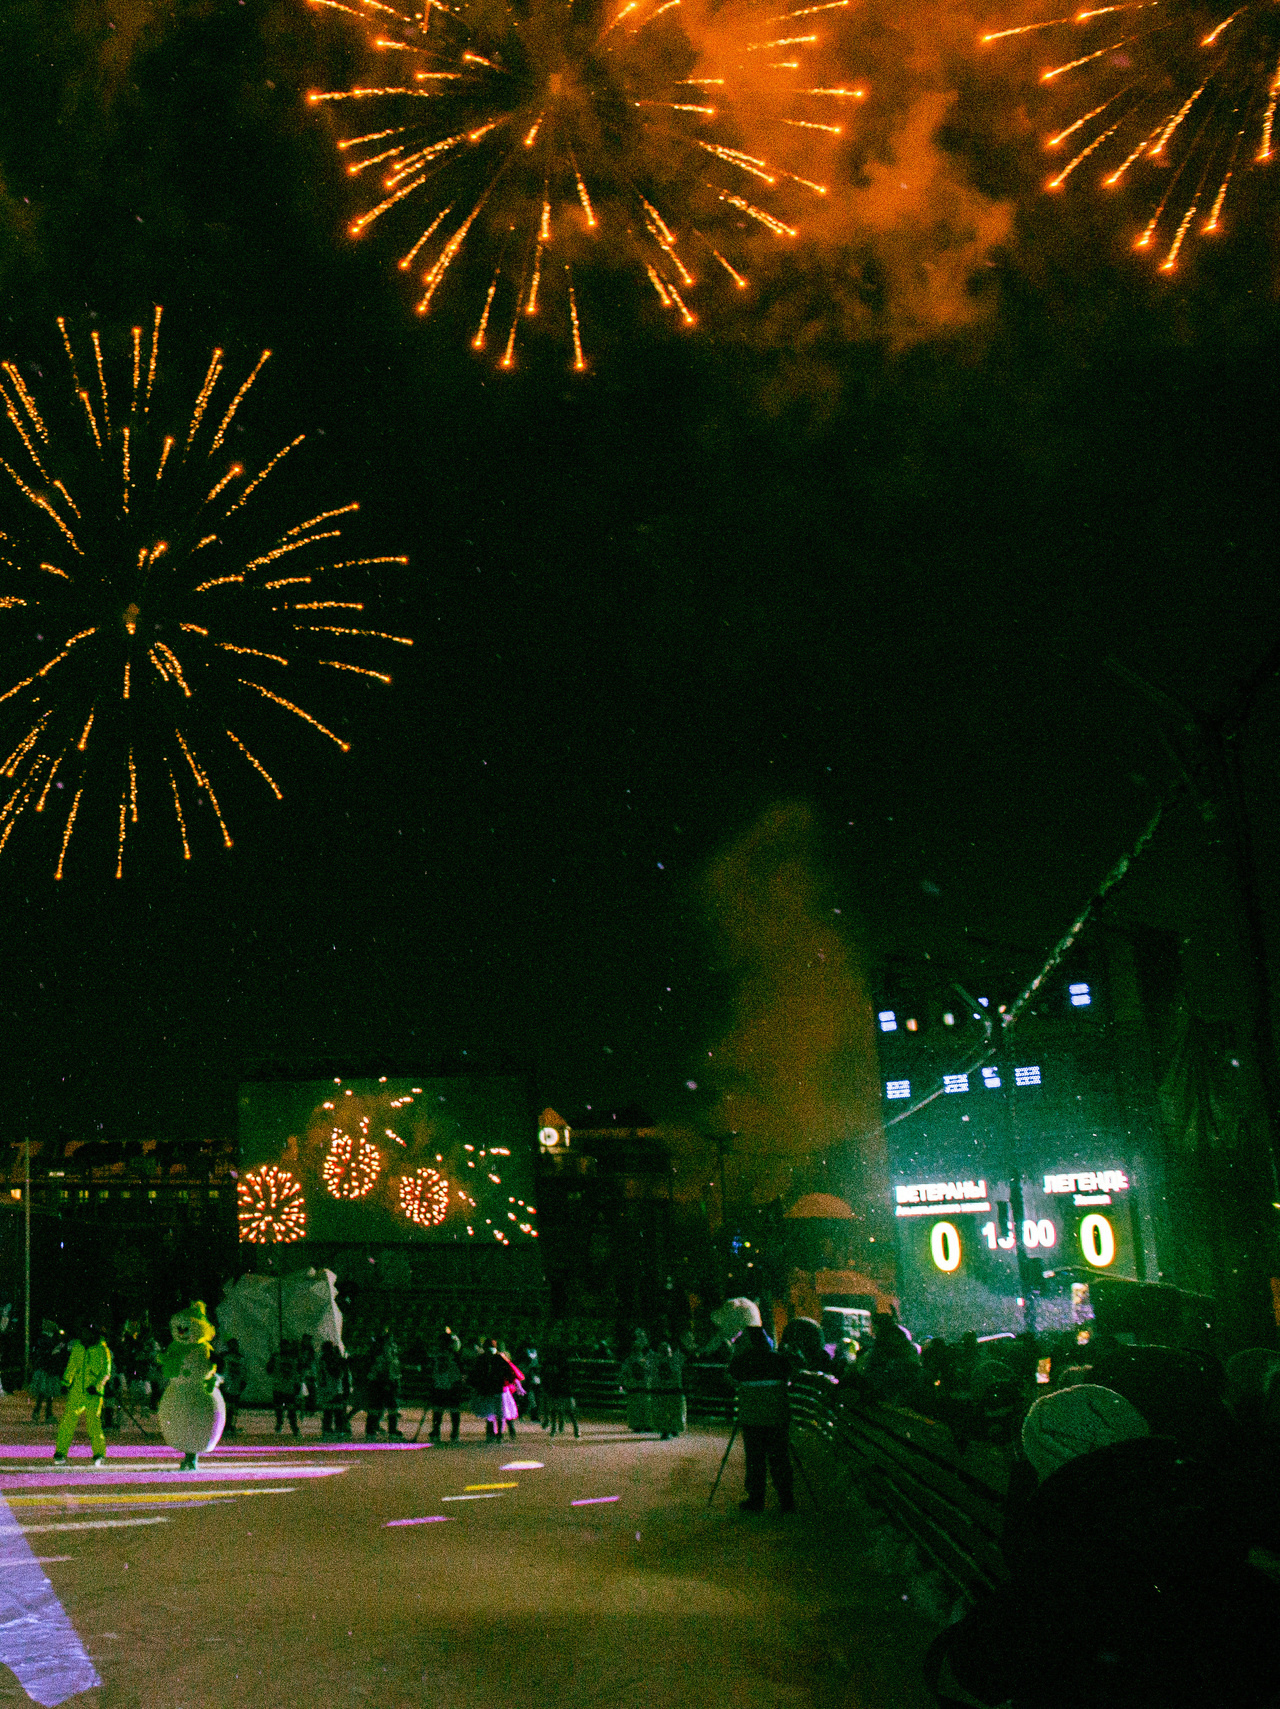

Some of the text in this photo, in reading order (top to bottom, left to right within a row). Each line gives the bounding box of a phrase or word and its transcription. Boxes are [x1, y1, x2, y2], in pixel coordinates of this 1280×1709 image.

[895, 1180, 987, 1203] ВЕТЕРАНЫ
[930, 1221, 961, 1272] 0
[1081, 1213, 1116, 1268] 0
